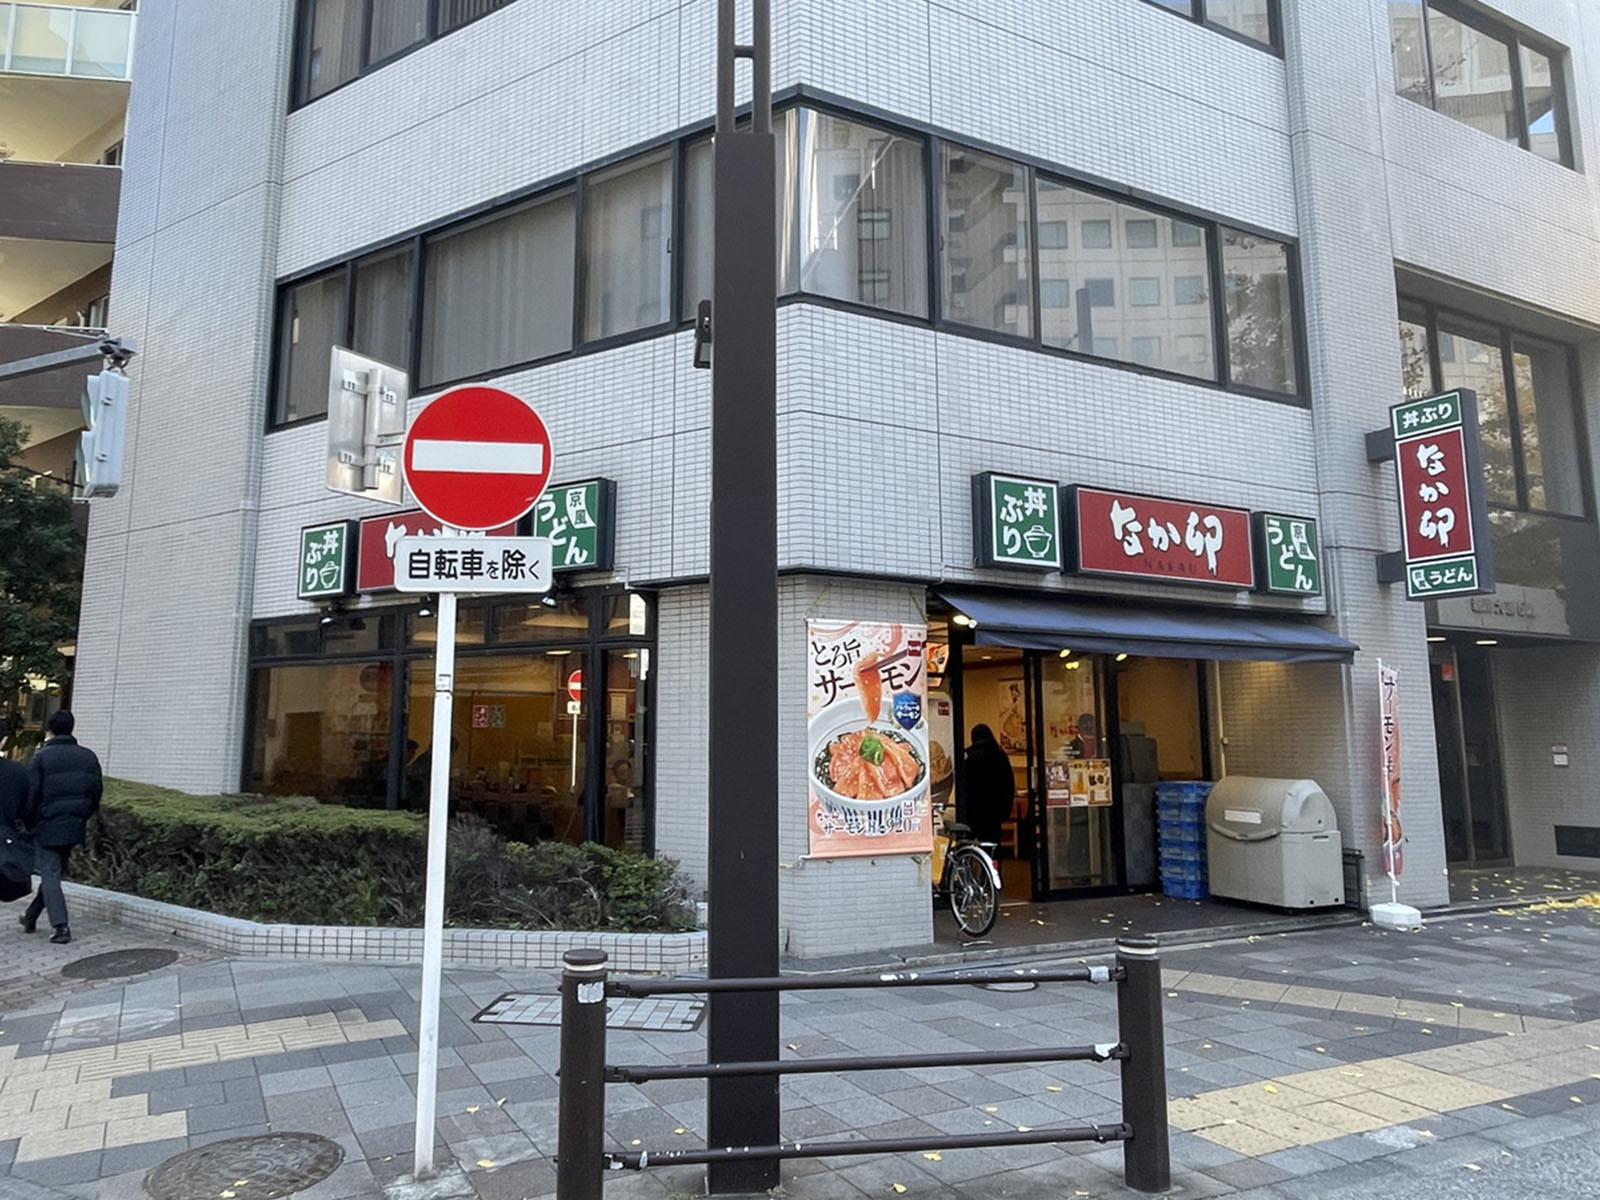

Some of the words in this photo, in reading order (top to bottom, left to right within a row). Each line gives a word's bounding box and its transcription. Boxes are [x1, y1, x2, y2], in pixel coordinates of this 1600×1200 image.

[538, 493, 588, 565] うどん
[999, 486, 1048, 556] 丼ぶり
[1417, 443, 1455, 548] なか卯
[408, 549, 540, 580] 自転車を除く
[1110, 499, 1224, 577] なか卯
[1267, 519, 1313, 590] うどん
[1429, 567, 1473, 585] うどん
[811, 638, 861, 669] とろ旨
